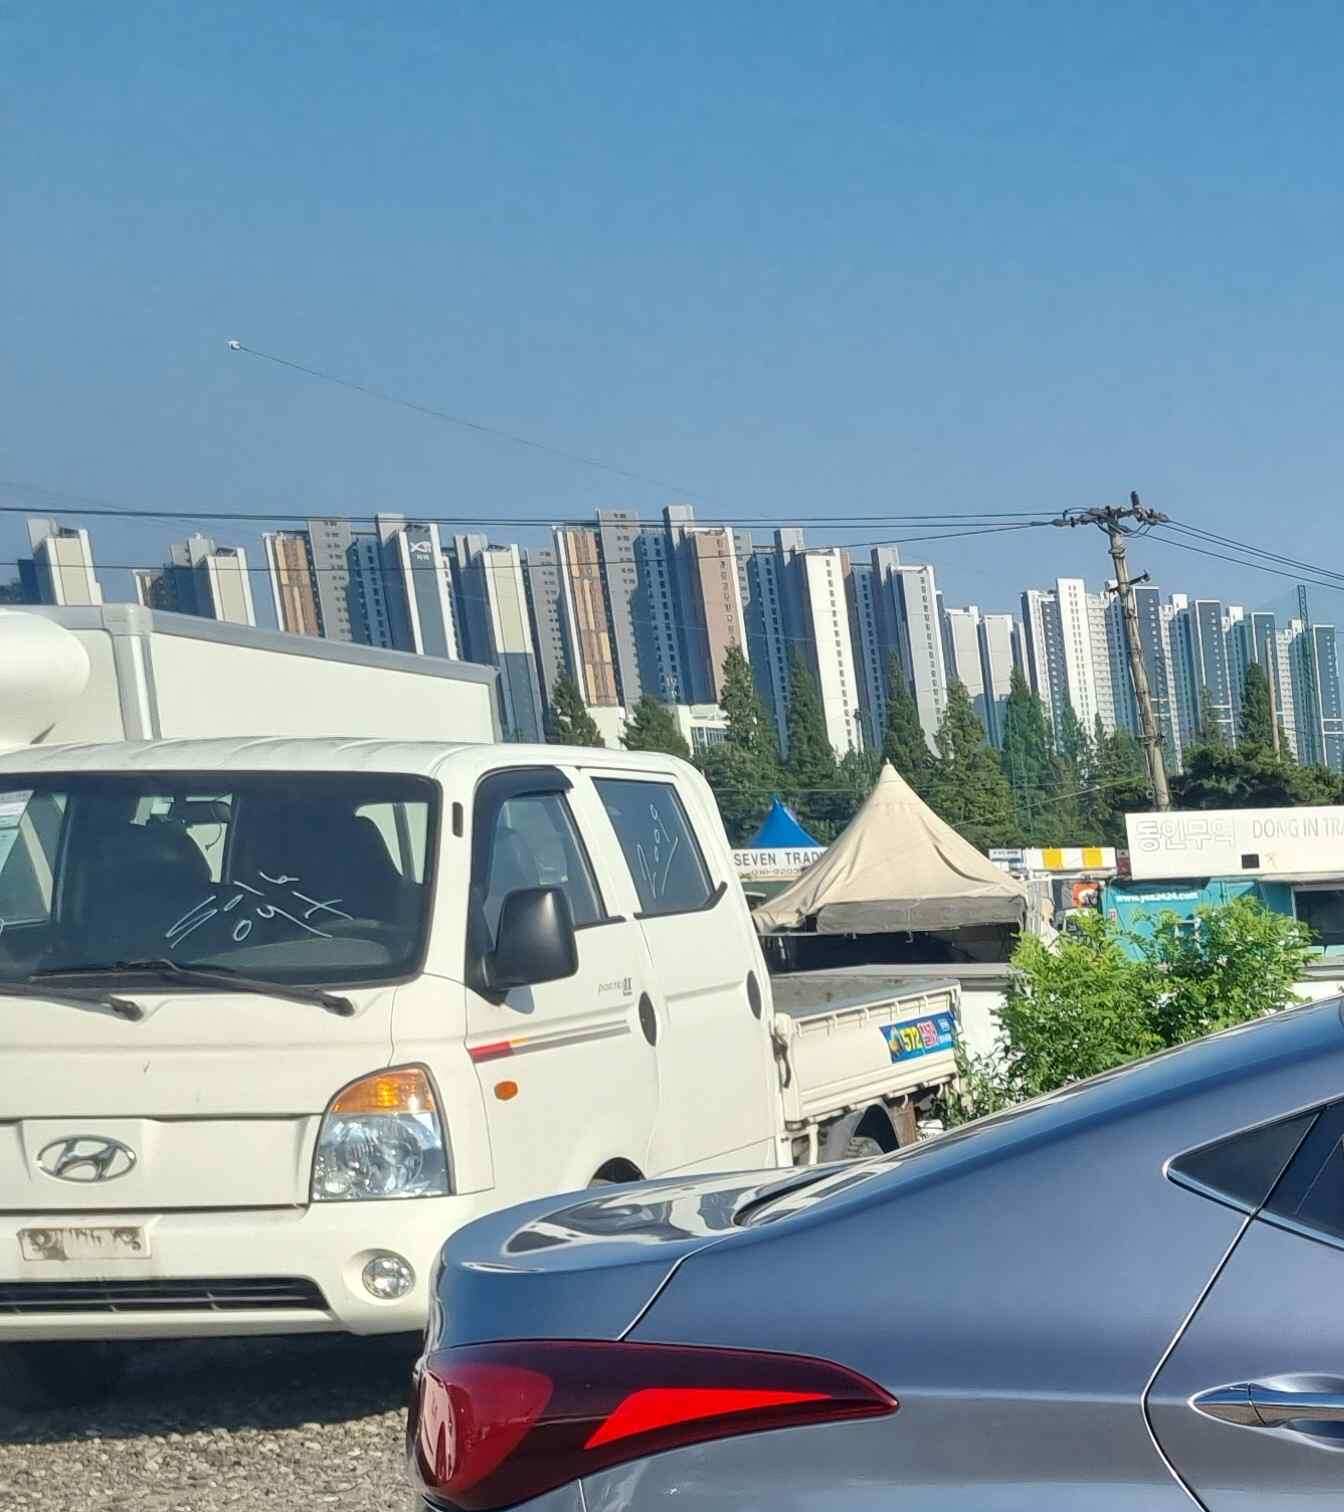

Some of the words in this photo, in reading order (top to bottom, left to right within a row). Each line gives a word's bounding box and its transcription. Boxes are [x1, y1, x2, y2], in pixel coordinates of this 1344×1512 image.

[1135, 817, 1238, 852] 동인무역
[1252, 818, 1297, 839] DONG
[1302, 817, 1320, 836] IN
[734, 853, 776, 866] SEVEN
